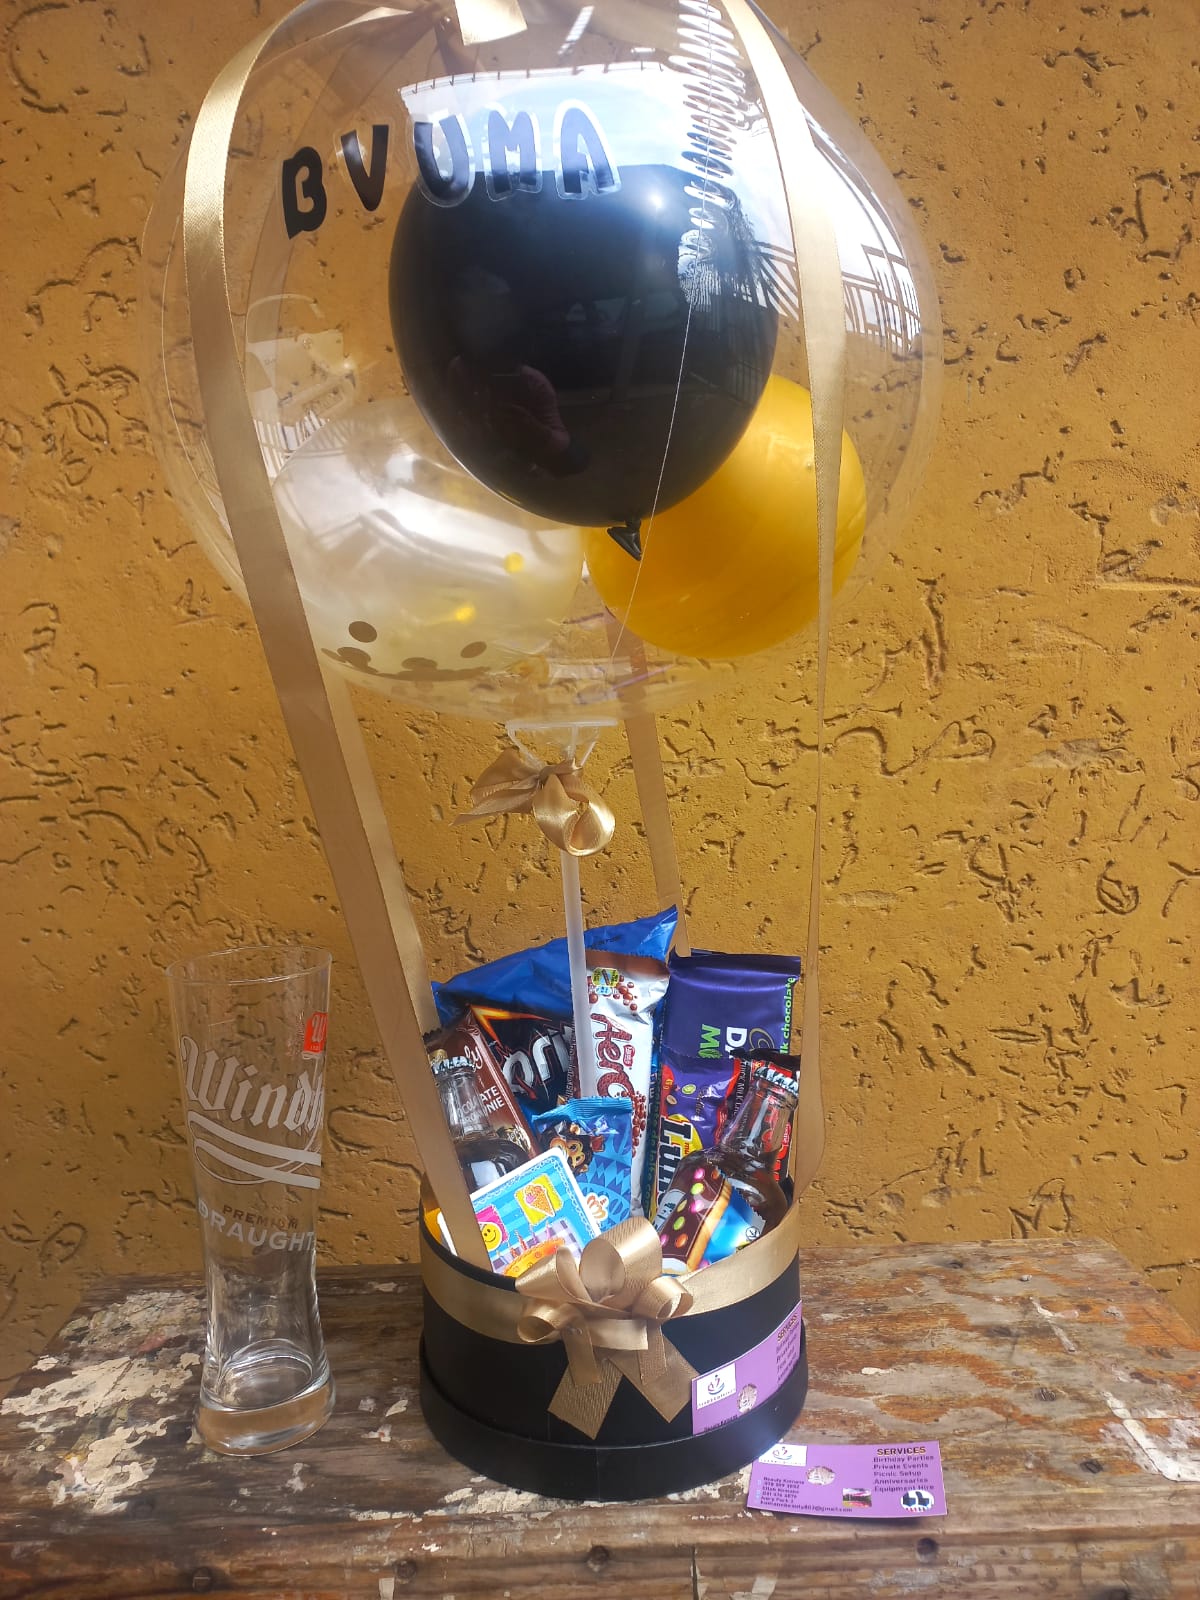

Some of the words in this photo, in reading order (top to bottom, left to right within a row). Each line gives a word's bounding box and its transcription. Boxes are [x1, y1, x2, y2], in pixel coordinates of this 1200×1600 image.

[281, 107, 617, 239] BVUMA
[780, 977, 796, 1039] chocolate
[590, 1013, 635, 1098] Aero
[877, 1446, 926, 1456] SERVICES
